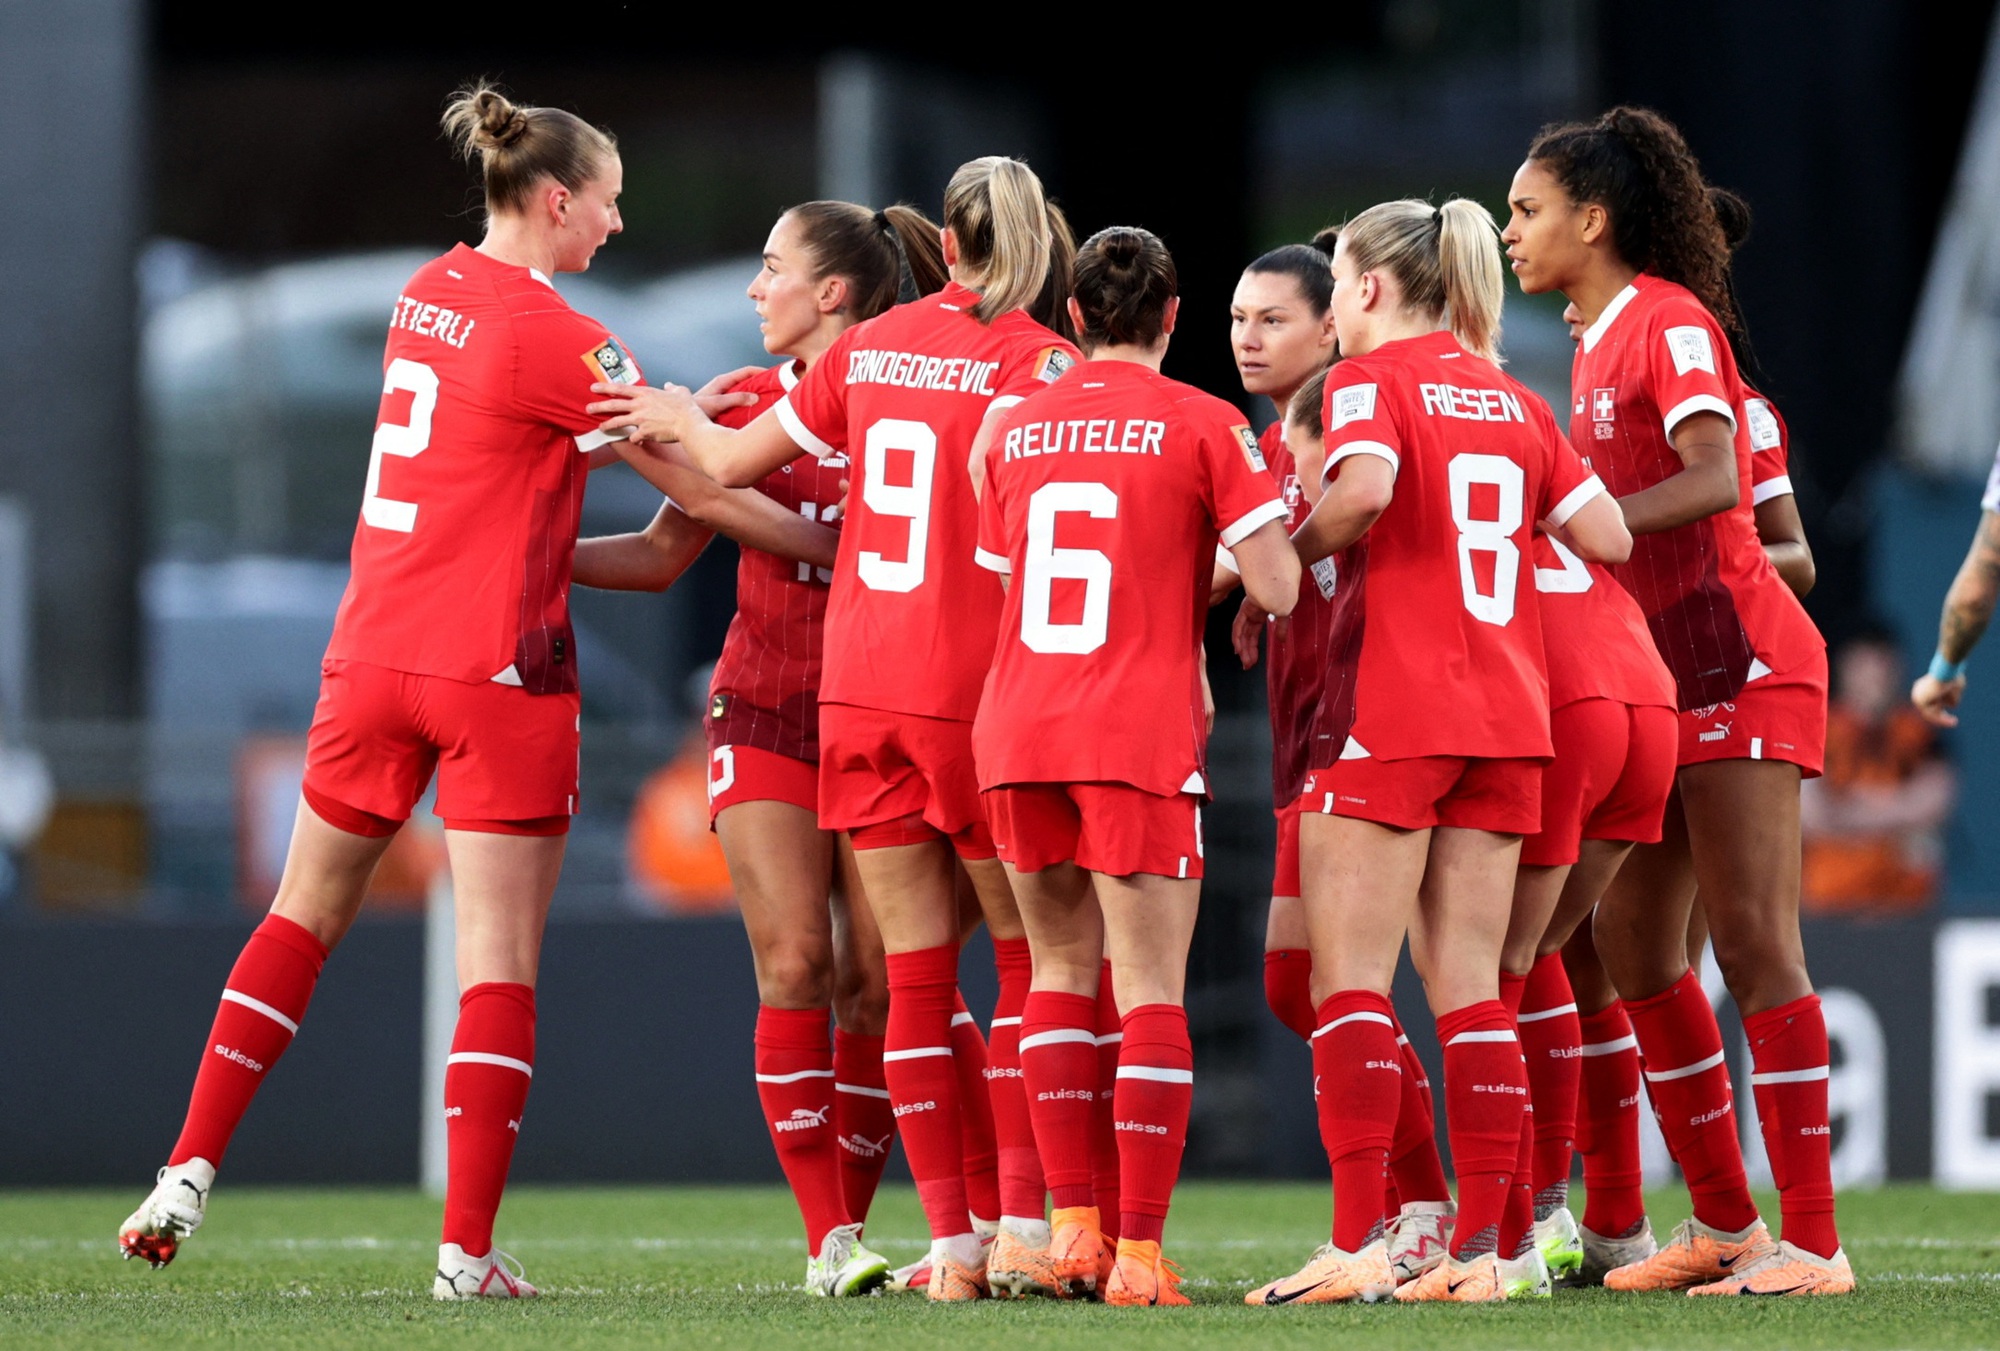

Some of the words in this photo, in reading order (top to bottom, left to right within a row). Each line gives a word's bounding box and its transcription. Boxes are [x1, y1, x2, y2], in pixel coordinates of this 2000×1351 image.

[1419, 383, 1525, 423] RIESEN
[361, 357, 440, 533] 2
[1004, 420, 1166, 462] REUTELER
[857, 417, 937, 593] 9
[1447, 452, 1525, 627] 8
[1020, 481, 1118, 655] 6
[214, 1044, 263, 1072] suisse
[892, 1100, 937, 1119] uisse
[1037, 1088, 1093, 1101] suisse
[774, 1116, 820, 1133] PUMA
[1114, 1120, 1168, 1135] suisse
